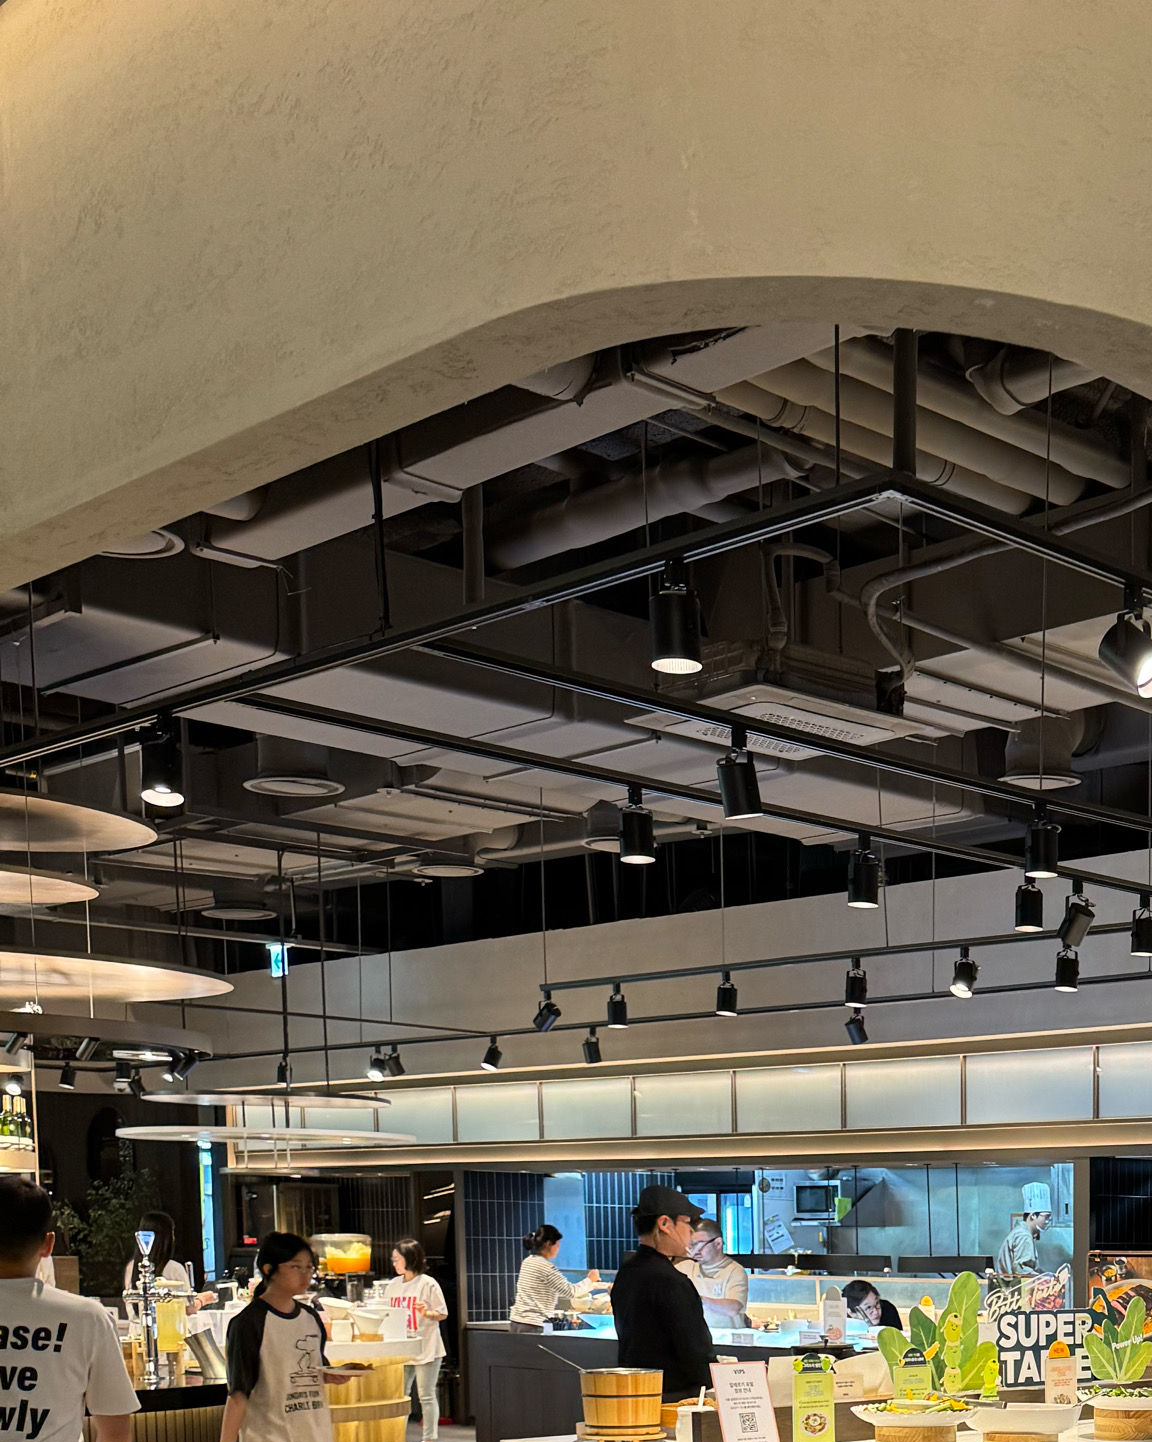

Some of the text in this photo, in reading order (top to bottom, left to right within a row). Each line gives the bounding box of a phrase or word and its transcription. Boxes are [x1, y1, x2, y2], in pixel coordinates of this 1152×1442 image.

[1000, 1313, 1092, 1348] SUPER
[1112, 1335, 1144, 1350] Power Up!
[1000, 1350, 1092, 1384] TAE
